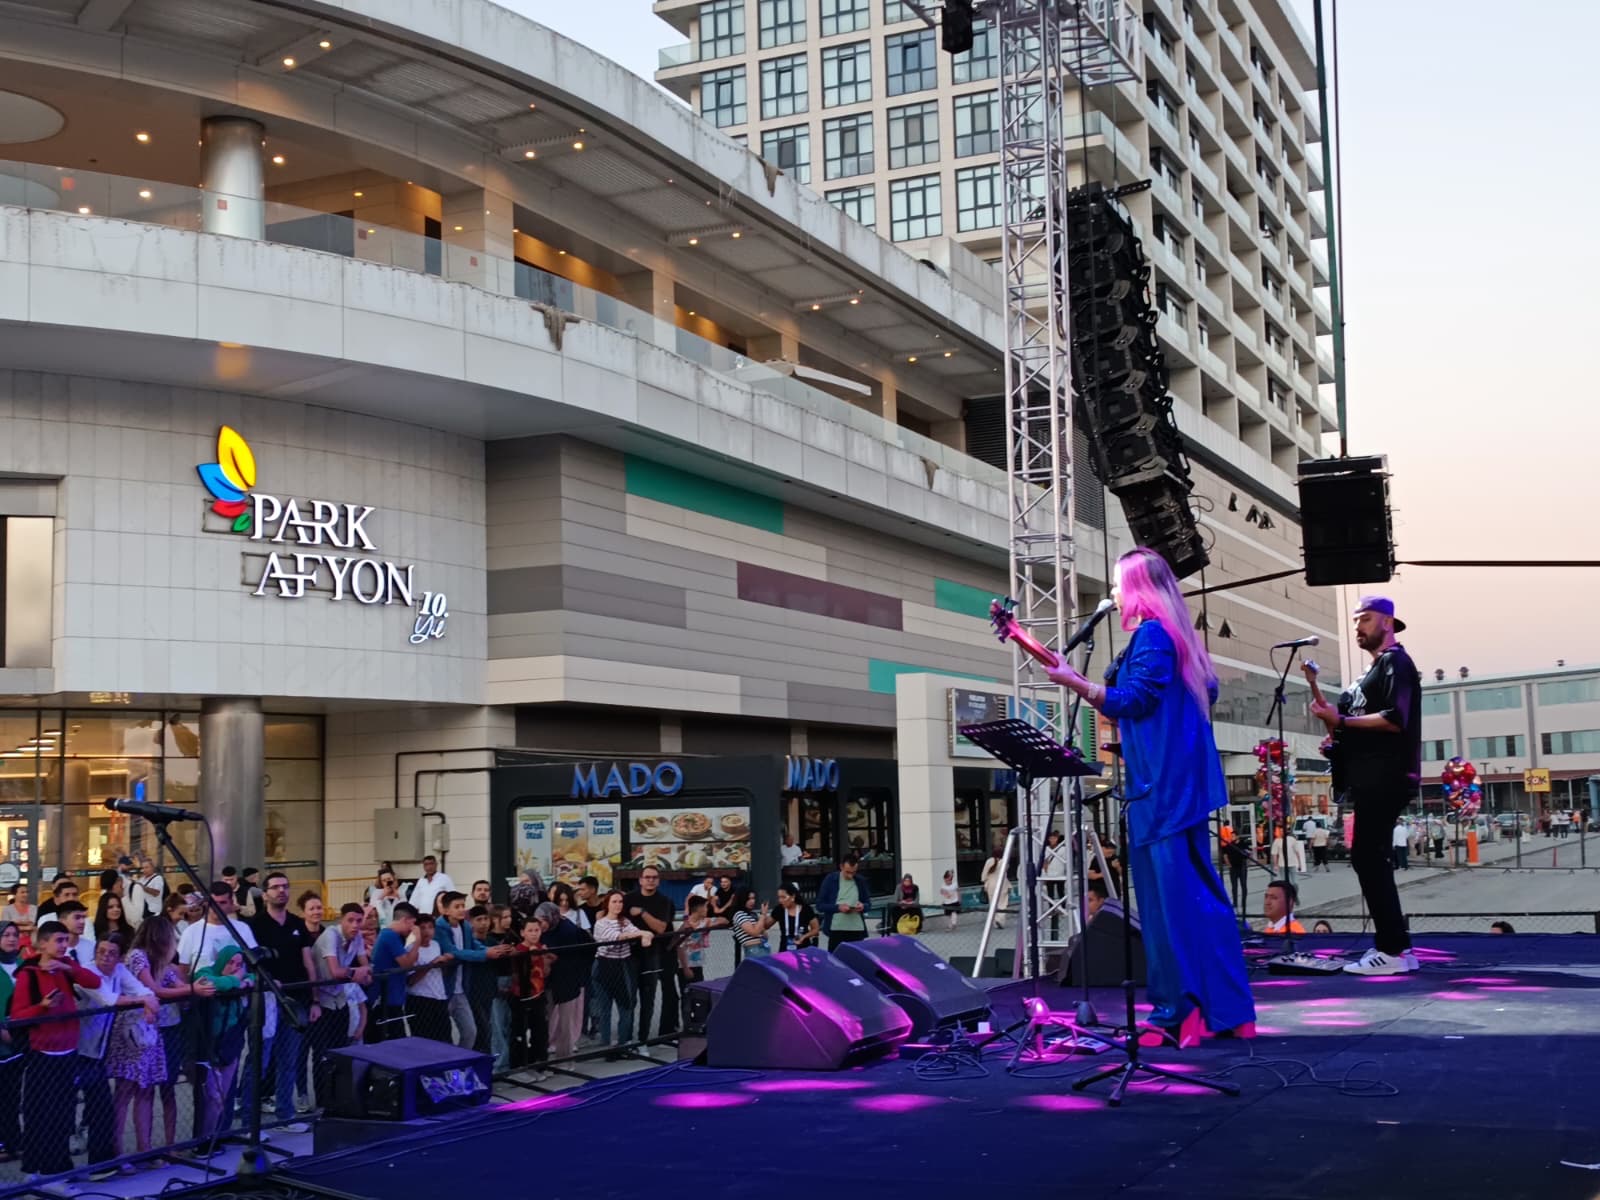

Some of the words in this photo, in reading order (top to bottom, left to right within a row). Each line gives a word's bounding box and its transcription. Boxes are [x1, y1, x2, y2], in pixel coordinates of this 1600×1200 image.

[251, 494, 377, 550] PARK
[253, 552, 415, 606] AFYON
[418, 591, 449, 618] 10.
[570, 761, 684, 798] MADO
[785, 755, 840, 791] MADO
